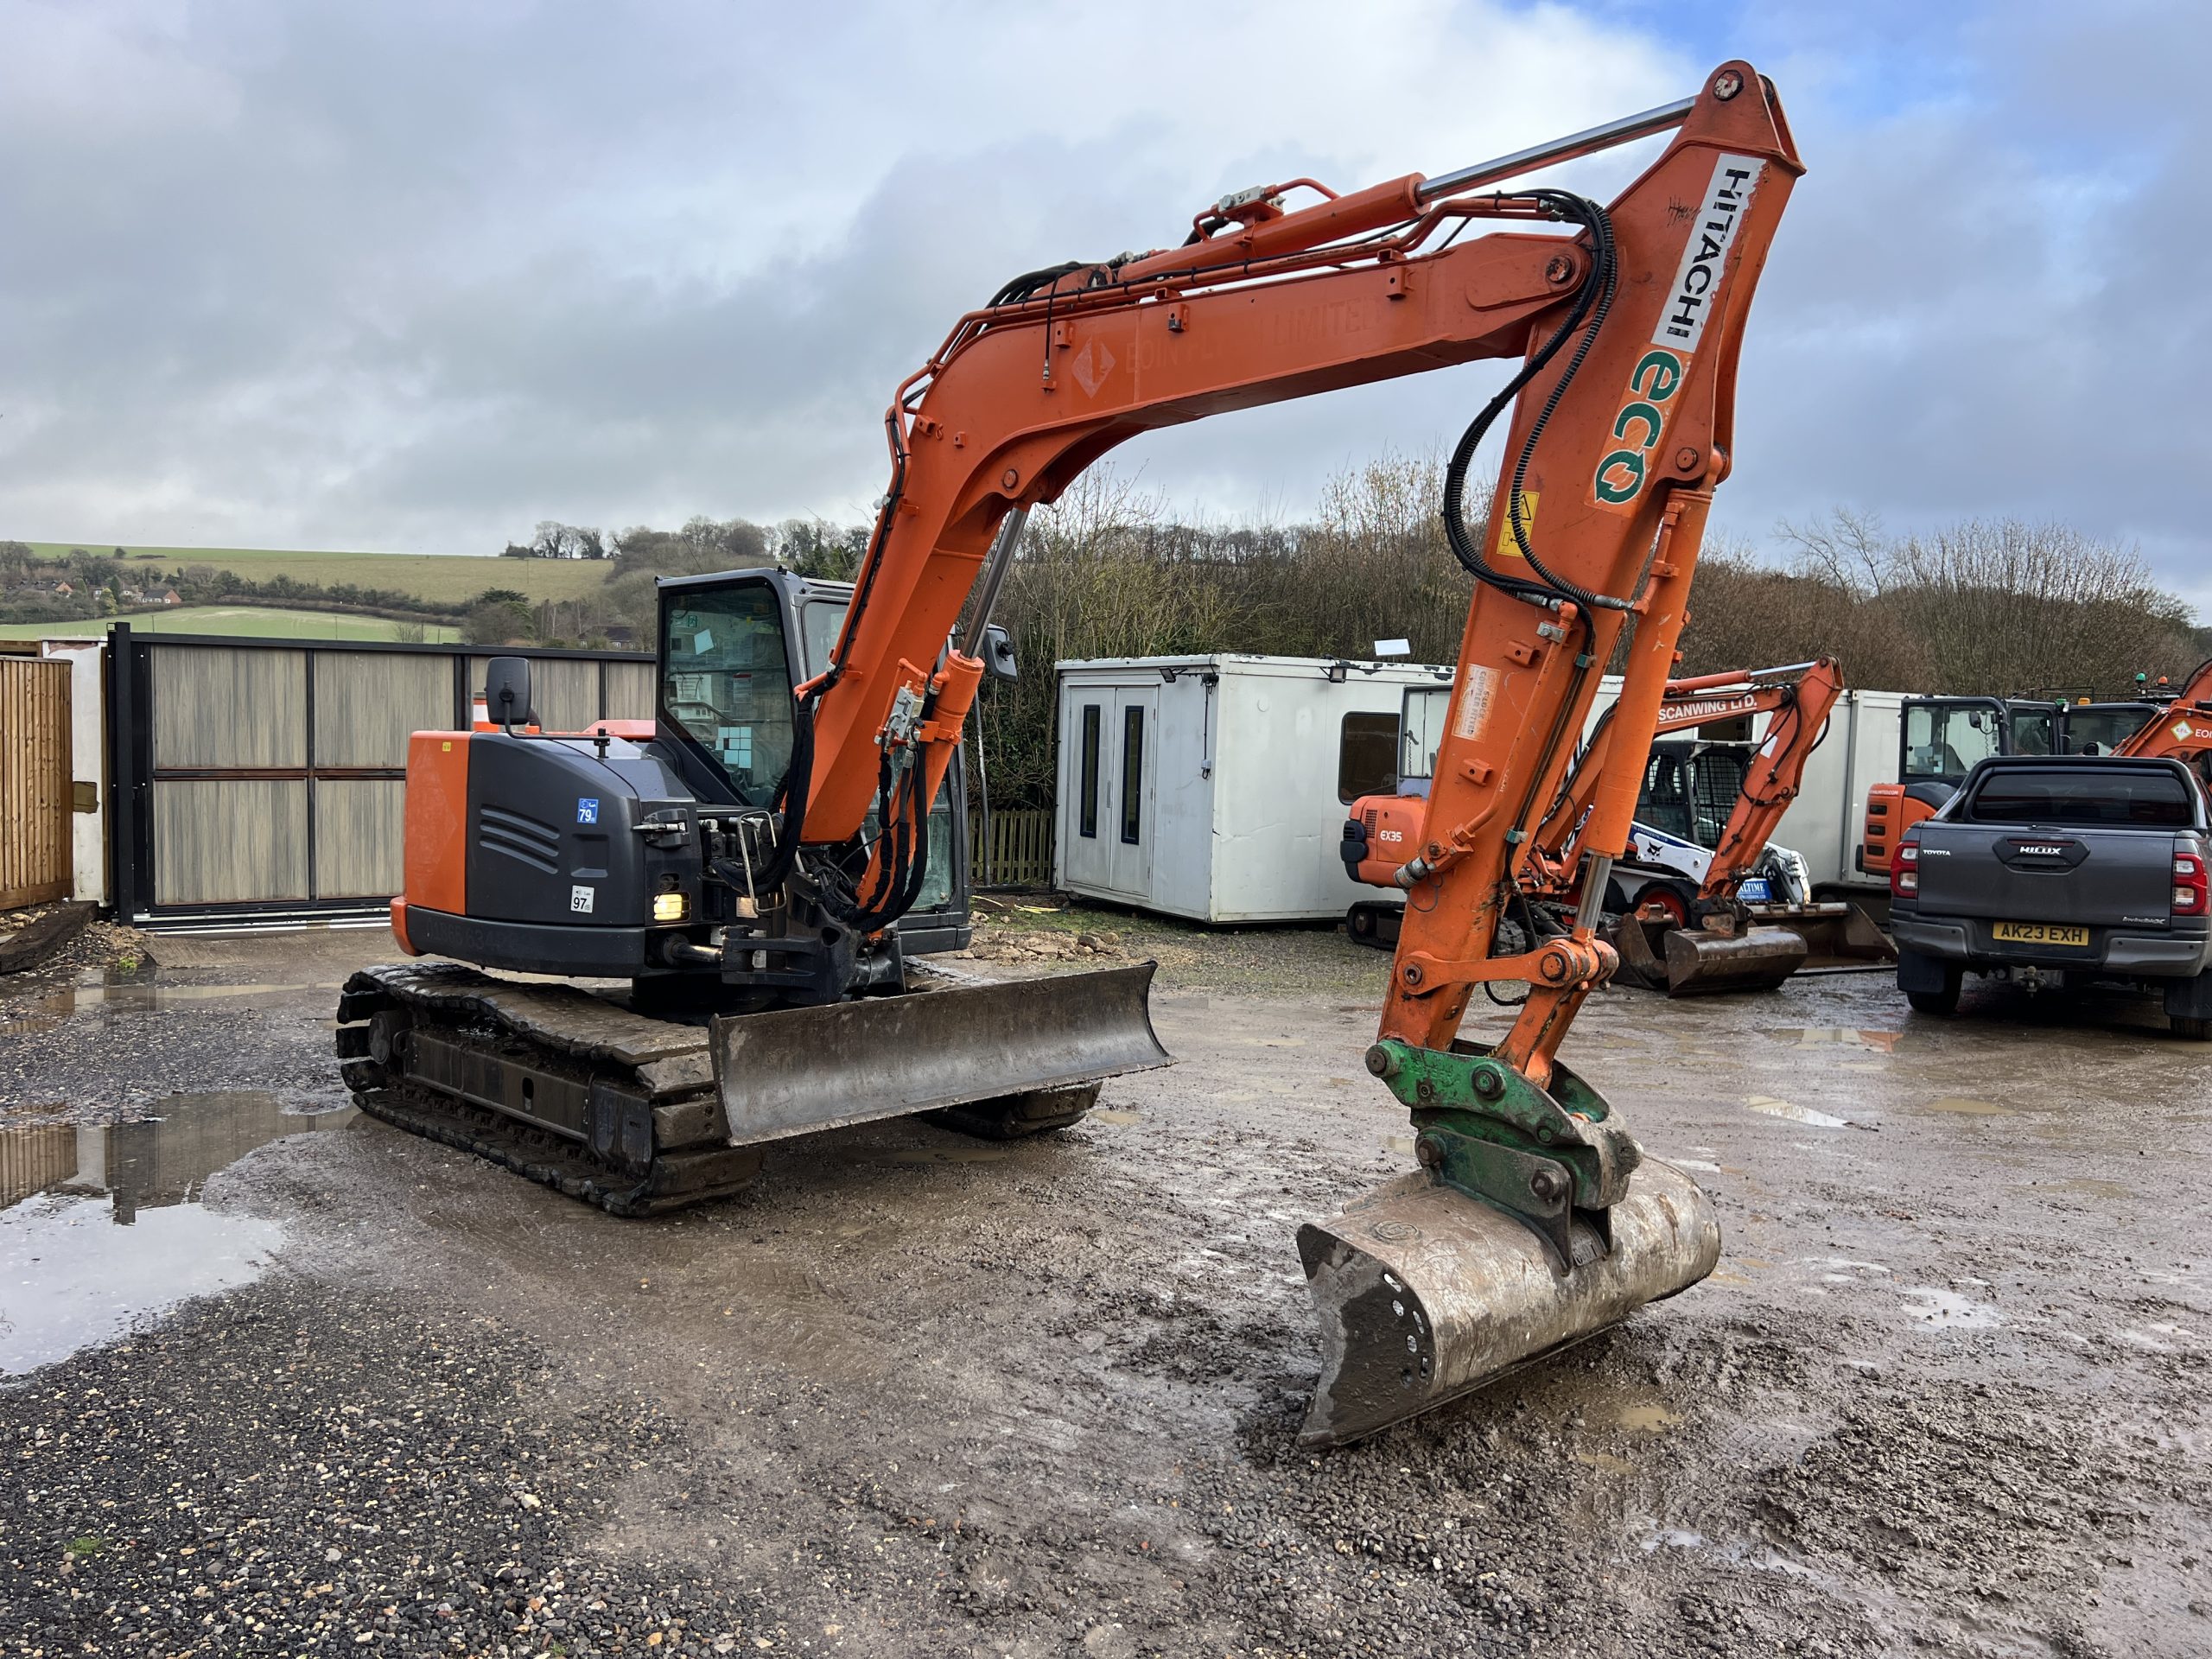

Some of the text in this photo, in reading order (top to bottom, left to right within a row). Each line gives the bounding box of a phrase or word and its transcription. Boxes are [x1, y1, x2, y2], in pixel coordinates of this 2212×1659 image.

[1668, 168, 1750, 339] HITACHI
[1594, 349, 1682, 504] eco
[1658, 700, 1726, 721] SCANWING
[2195, 728, 2212, 739] EOI
[579, 809, 592, 822] 79
[1380, 830, 1402, 842] EX35
[2019, 846, 2063, 855] HILUX
[573, 896, 587, 910] 97
[2001, 924, 2082, 943] AK23 EXH
